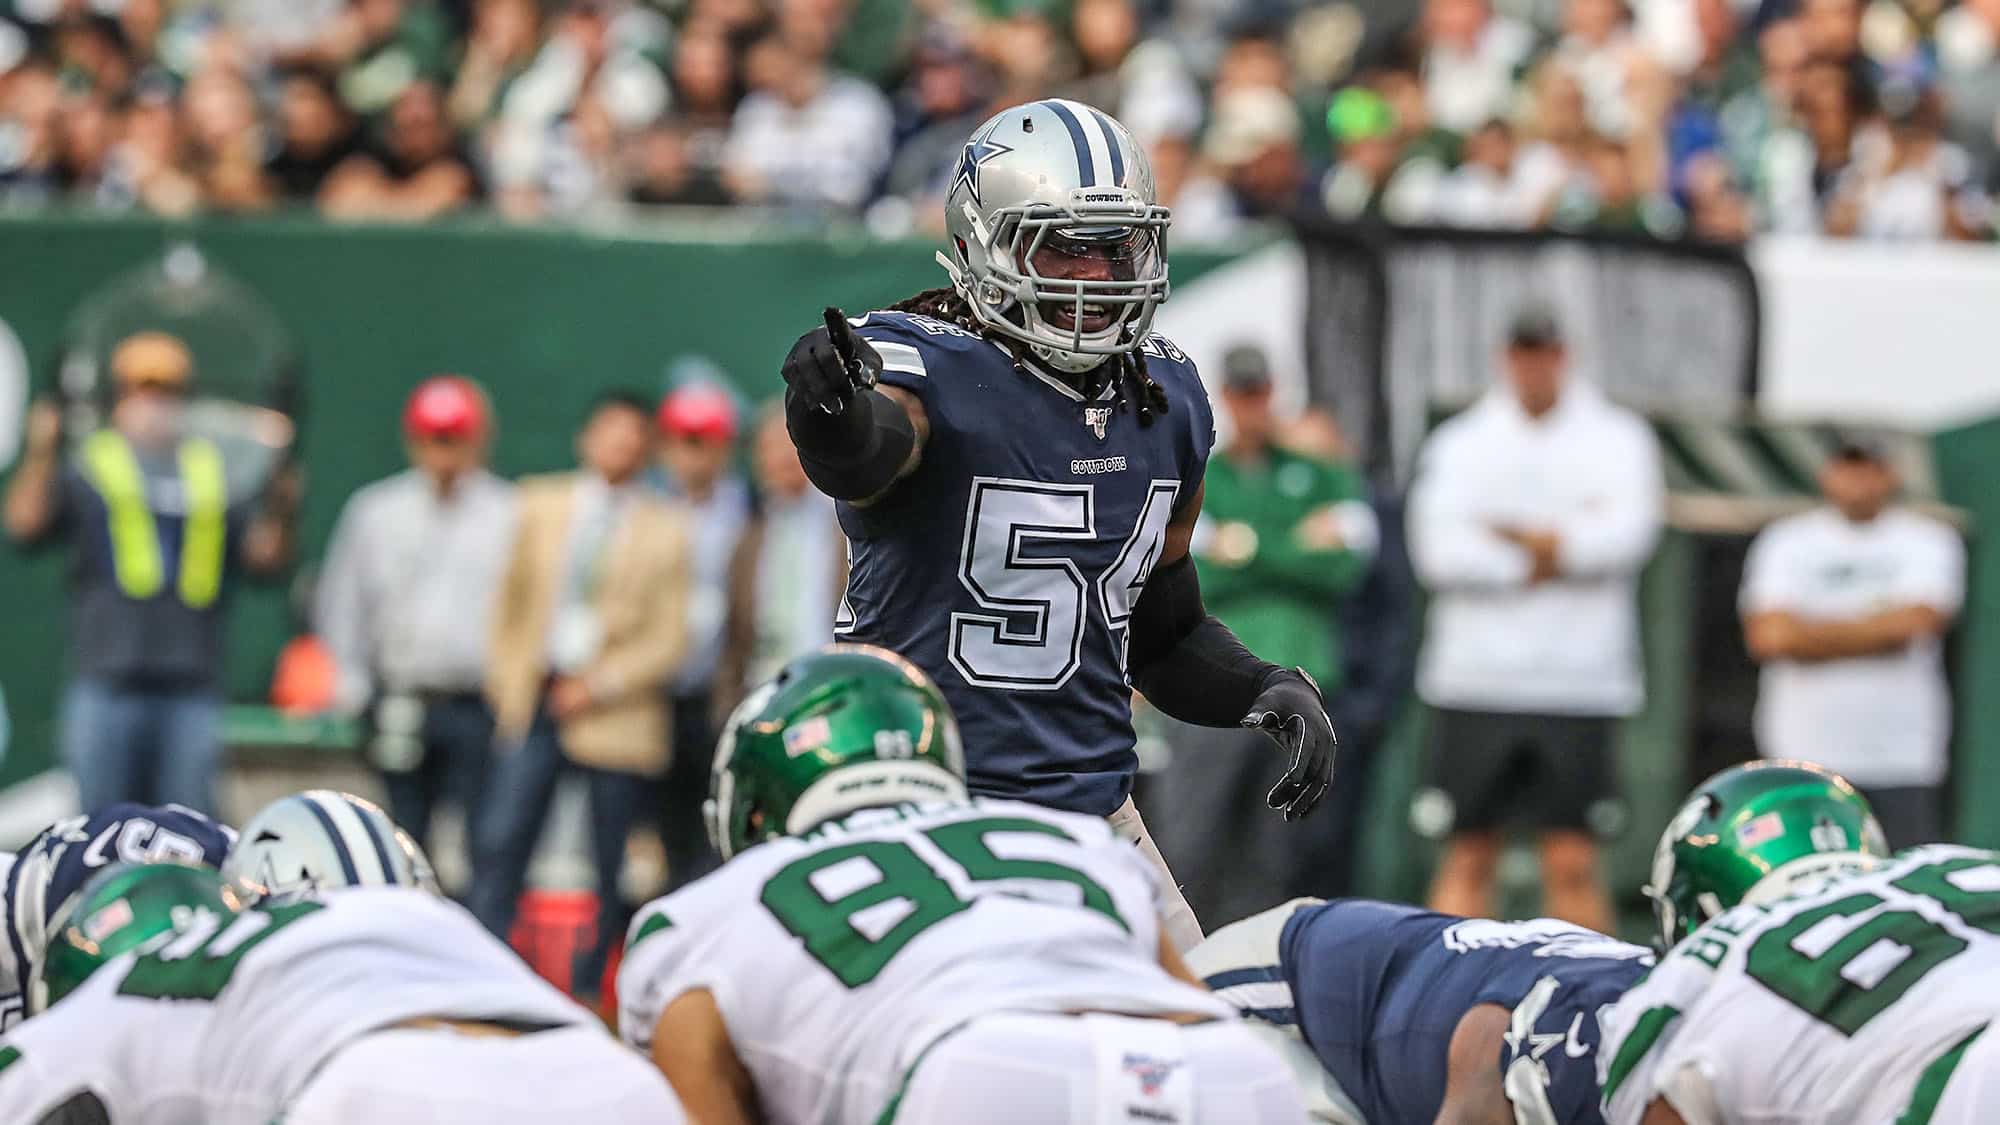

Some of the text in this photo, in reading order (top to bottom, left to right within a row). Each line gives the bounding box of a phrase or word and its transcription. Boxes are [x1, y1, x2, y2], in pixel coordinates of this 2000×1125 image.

[1085, 194, 1124, 202] COWBOYS
[1071, 456, 1127, 475] COWBOYS
[947, 476, 1181, 690] 54
[760, 817, 1132, 988] 85
